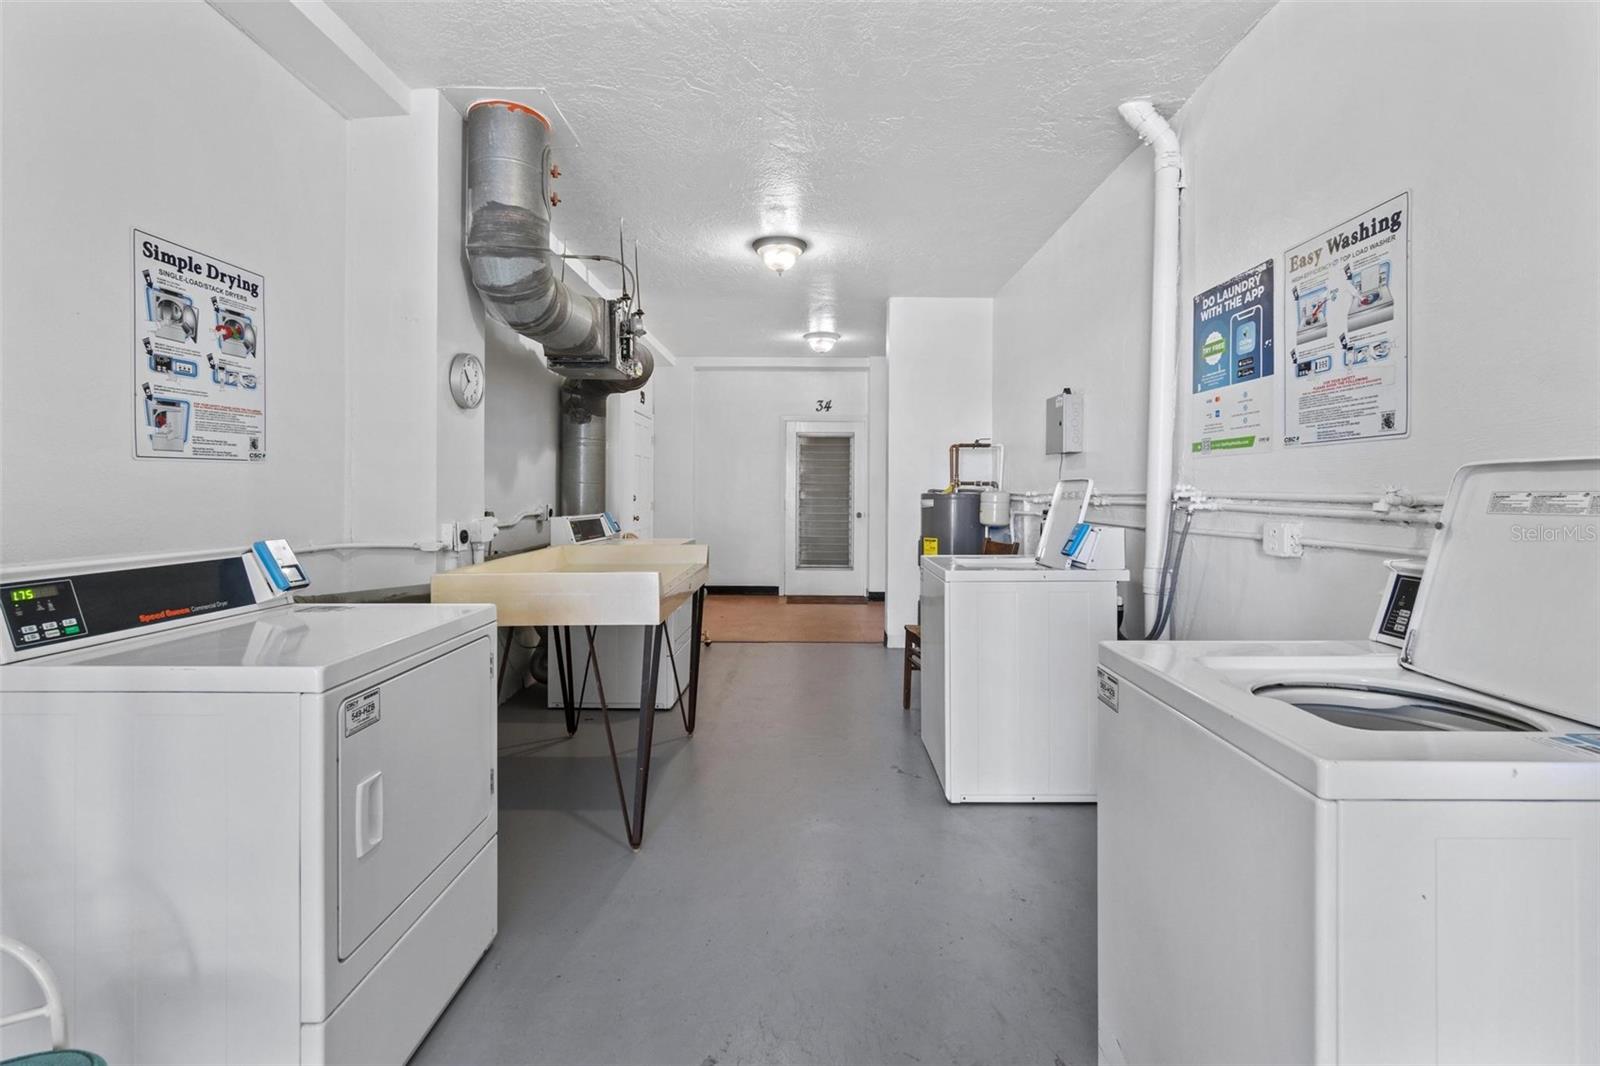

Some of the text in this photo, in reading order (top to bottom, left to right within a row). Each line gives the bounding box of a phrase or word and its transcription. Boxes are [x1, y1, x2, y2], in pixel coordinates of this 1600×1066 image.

[1289, 247, 1322, 274] Easy
[1326, 210, 1402, 255] Washing
[1352, 246, 1368, 259] LOAD
[1369, 234, 1396, 251] WASHER
[142, 240, 259, 298] Simple Drying
[1200, 285, 1265, 322] WITH THE APP
[1202, 273, 1262, 310] DO LAUNDRY
[815, 399, 832, 412] 34
[139, 610, 165, 623] Speed
